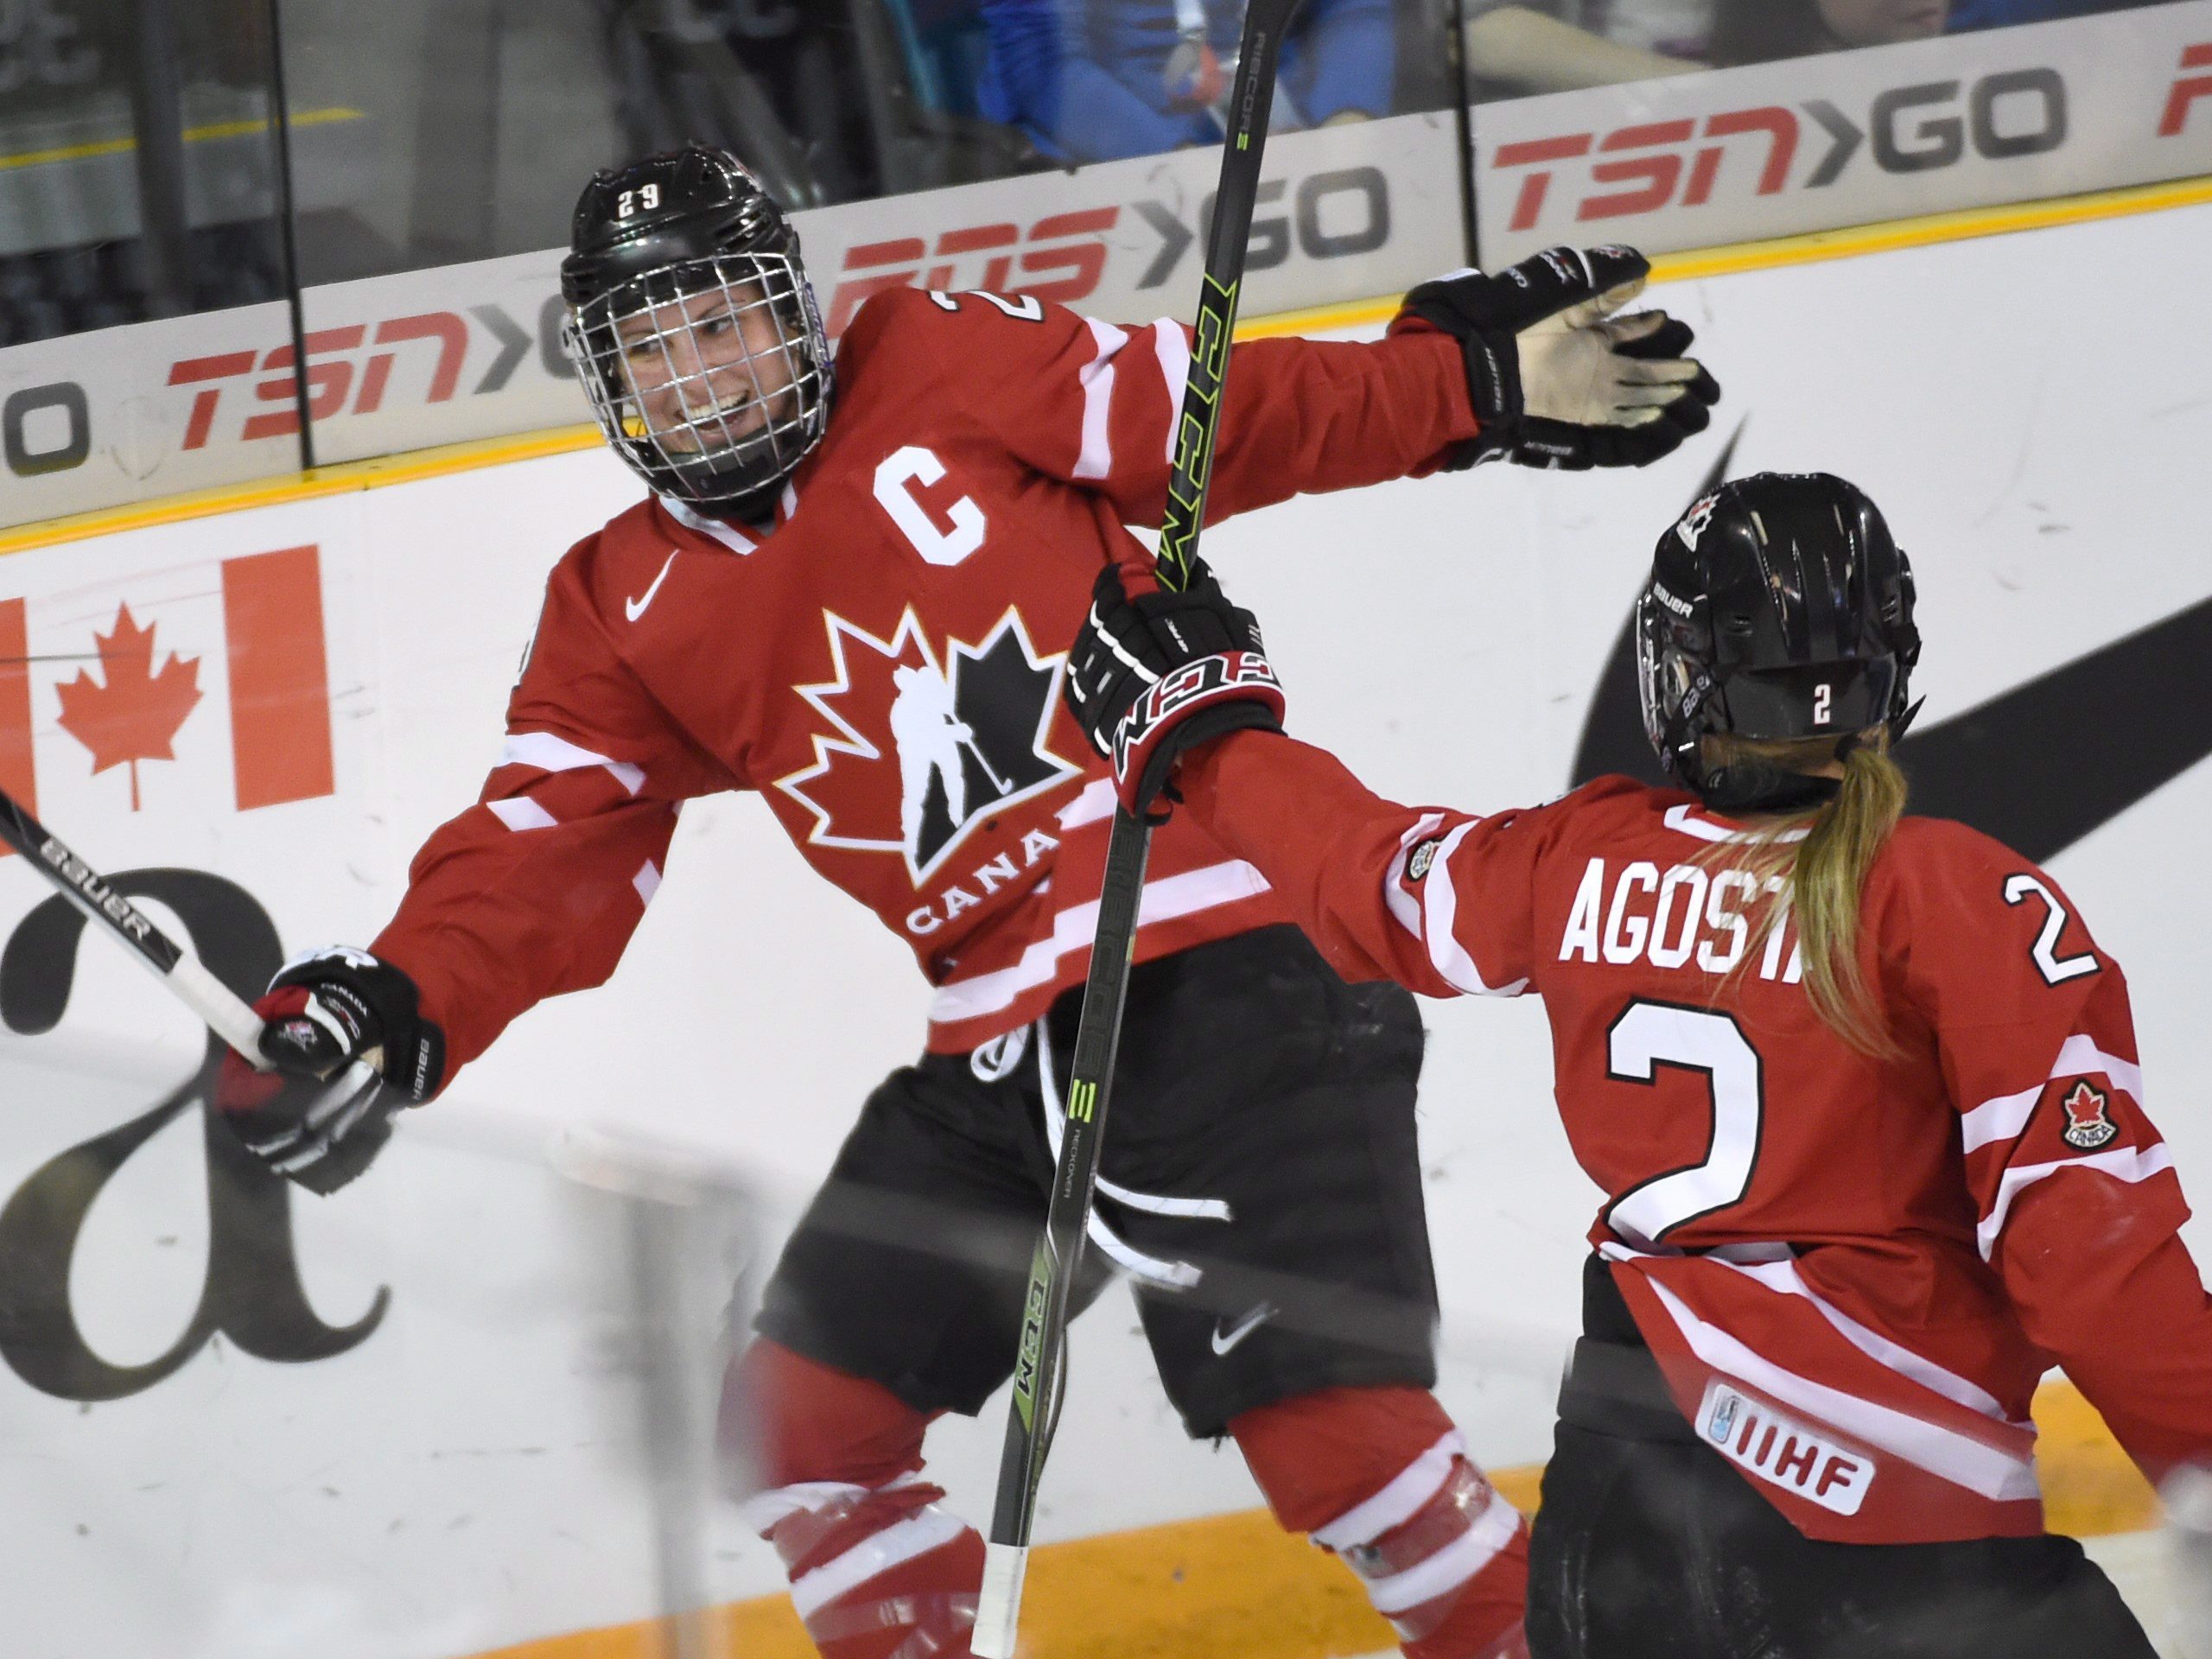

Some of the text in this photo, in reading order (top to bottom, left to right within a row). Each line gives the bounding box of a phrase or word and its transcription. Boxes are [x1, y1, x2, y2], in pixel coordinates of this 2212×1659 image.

[618, 183, 659, 219] 29
[1491, 106, 1800, 232] TSN
[1872, 67, 2067, 174] GO
[167, 311, 469, 451] TSN
[1154, 271, 1237, 593] CCM
[873, 445, 987, 567] C
[1814, 683, 1831, 725] 2
[906, 827, 1061, 936] CANA
[2001, 873, 2102, 988] 2
[1605, 997, 1764, 1245] 2
[1015, 1279, 1046, 1398] CCM
[1736, 1415, 1859, 1497] IIHF
